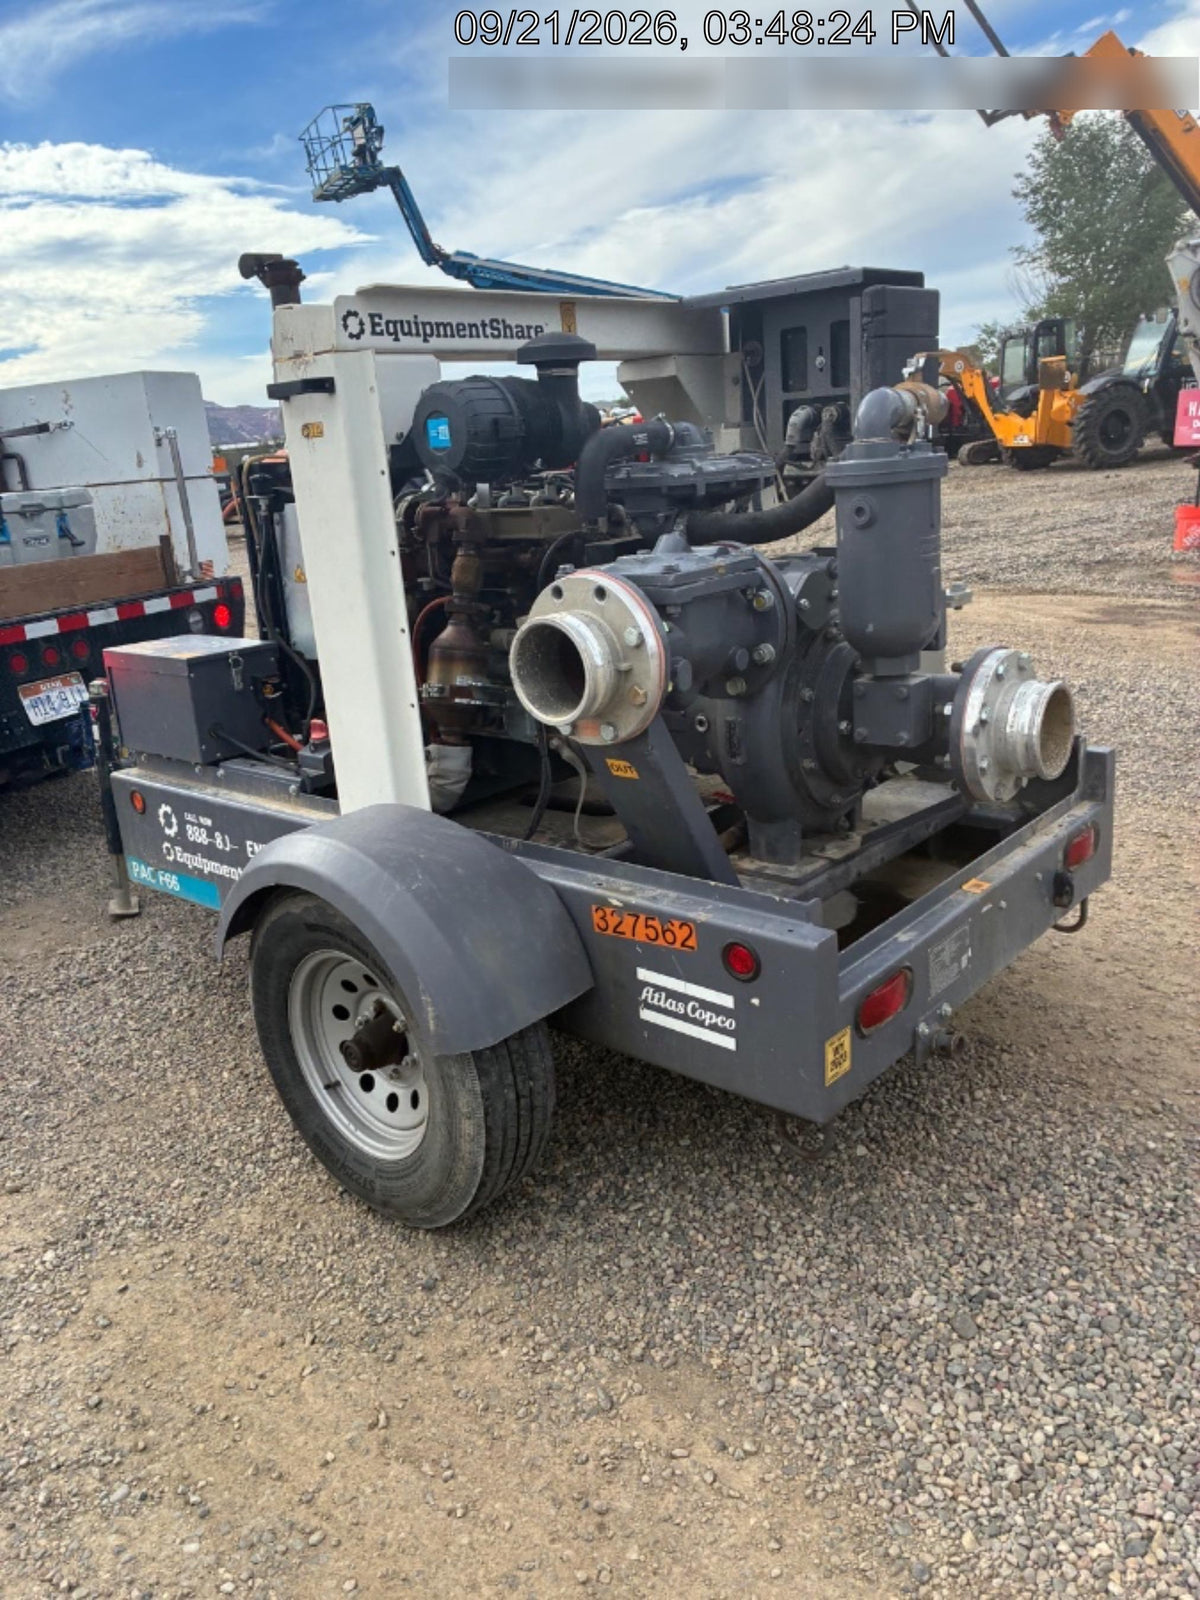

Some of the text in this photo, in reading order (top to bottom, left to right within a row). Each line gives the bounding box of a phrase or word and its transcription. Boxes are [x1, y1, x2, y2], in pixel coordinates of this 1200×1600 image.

[367, 312, 546, 343] EquipmentShare
[609, 761, 635, 775] OUT
[131, 861, 157, 884] PAC
[594, 907, 696, 950] 327562
[641, 985, 736, 1030] Atlas Copco
